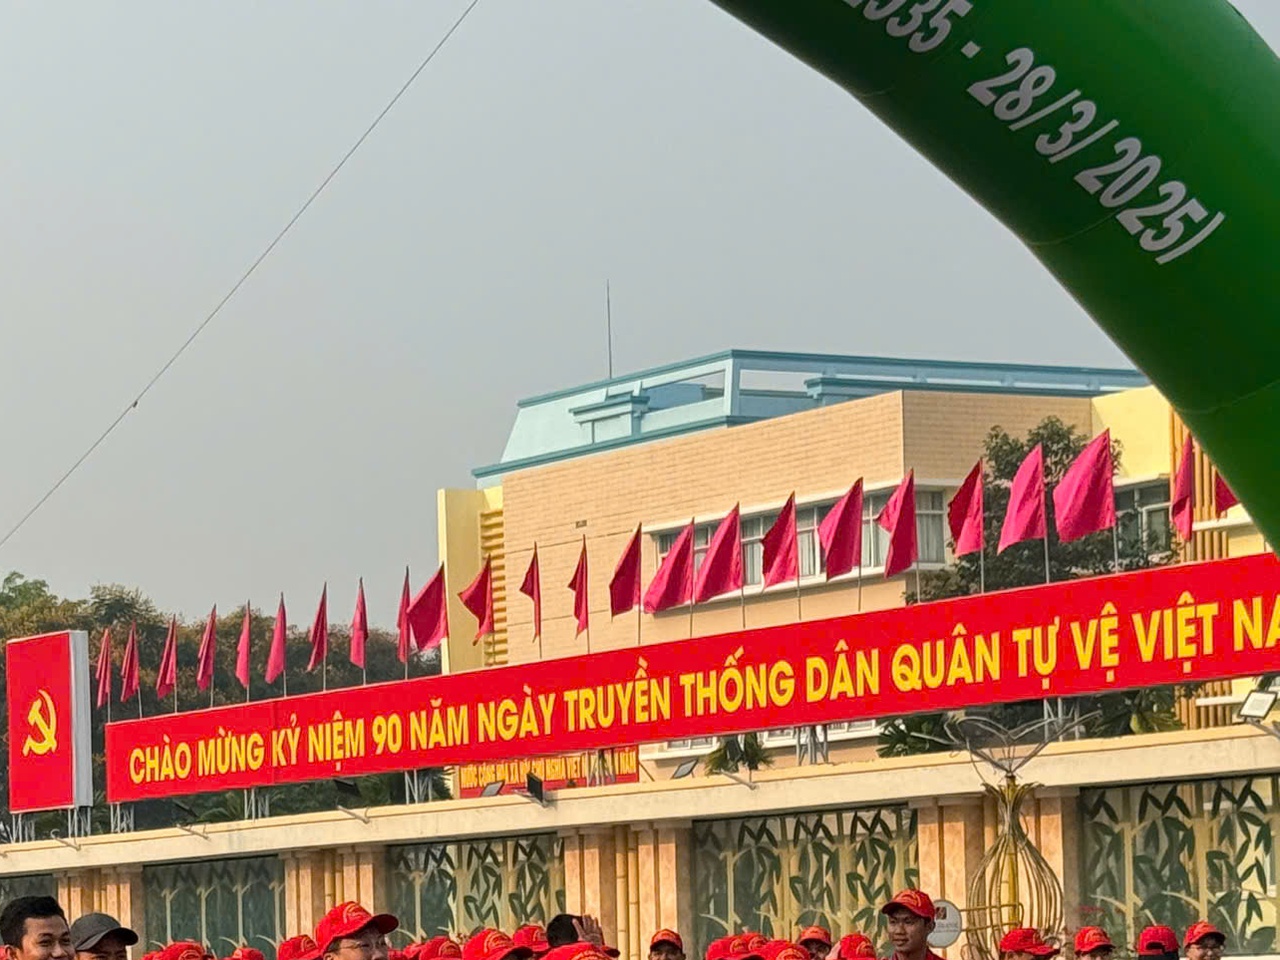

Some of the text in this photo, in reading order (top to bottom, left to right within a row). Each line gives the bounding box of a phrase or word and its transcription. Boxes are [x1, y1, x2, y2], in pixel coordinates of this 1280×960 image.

[129, 734, 192, 785] CHÀO
[197, 726, 265, 777] MỪNG
[271, 713, 302, 768] KỶ
[308, 710, 365, 771] NIỆM
[371, 713, 402, 755] 90
[409, 698, 469, 752] NĂM
[477, 685, 556, 743] NGÀY
[563, 656, 671, 732] TRUYỀN
[679, 646, 796, 717] THỐNG
[806, 639, 880, 704] DÂN
[891, 623, 1001, 693] QUÂN
[1012, 616, 1060, 690] TỰ
[1070, 601, 1120, 682] VỆ
[1131, 591, 1219, 674] VIỆT
